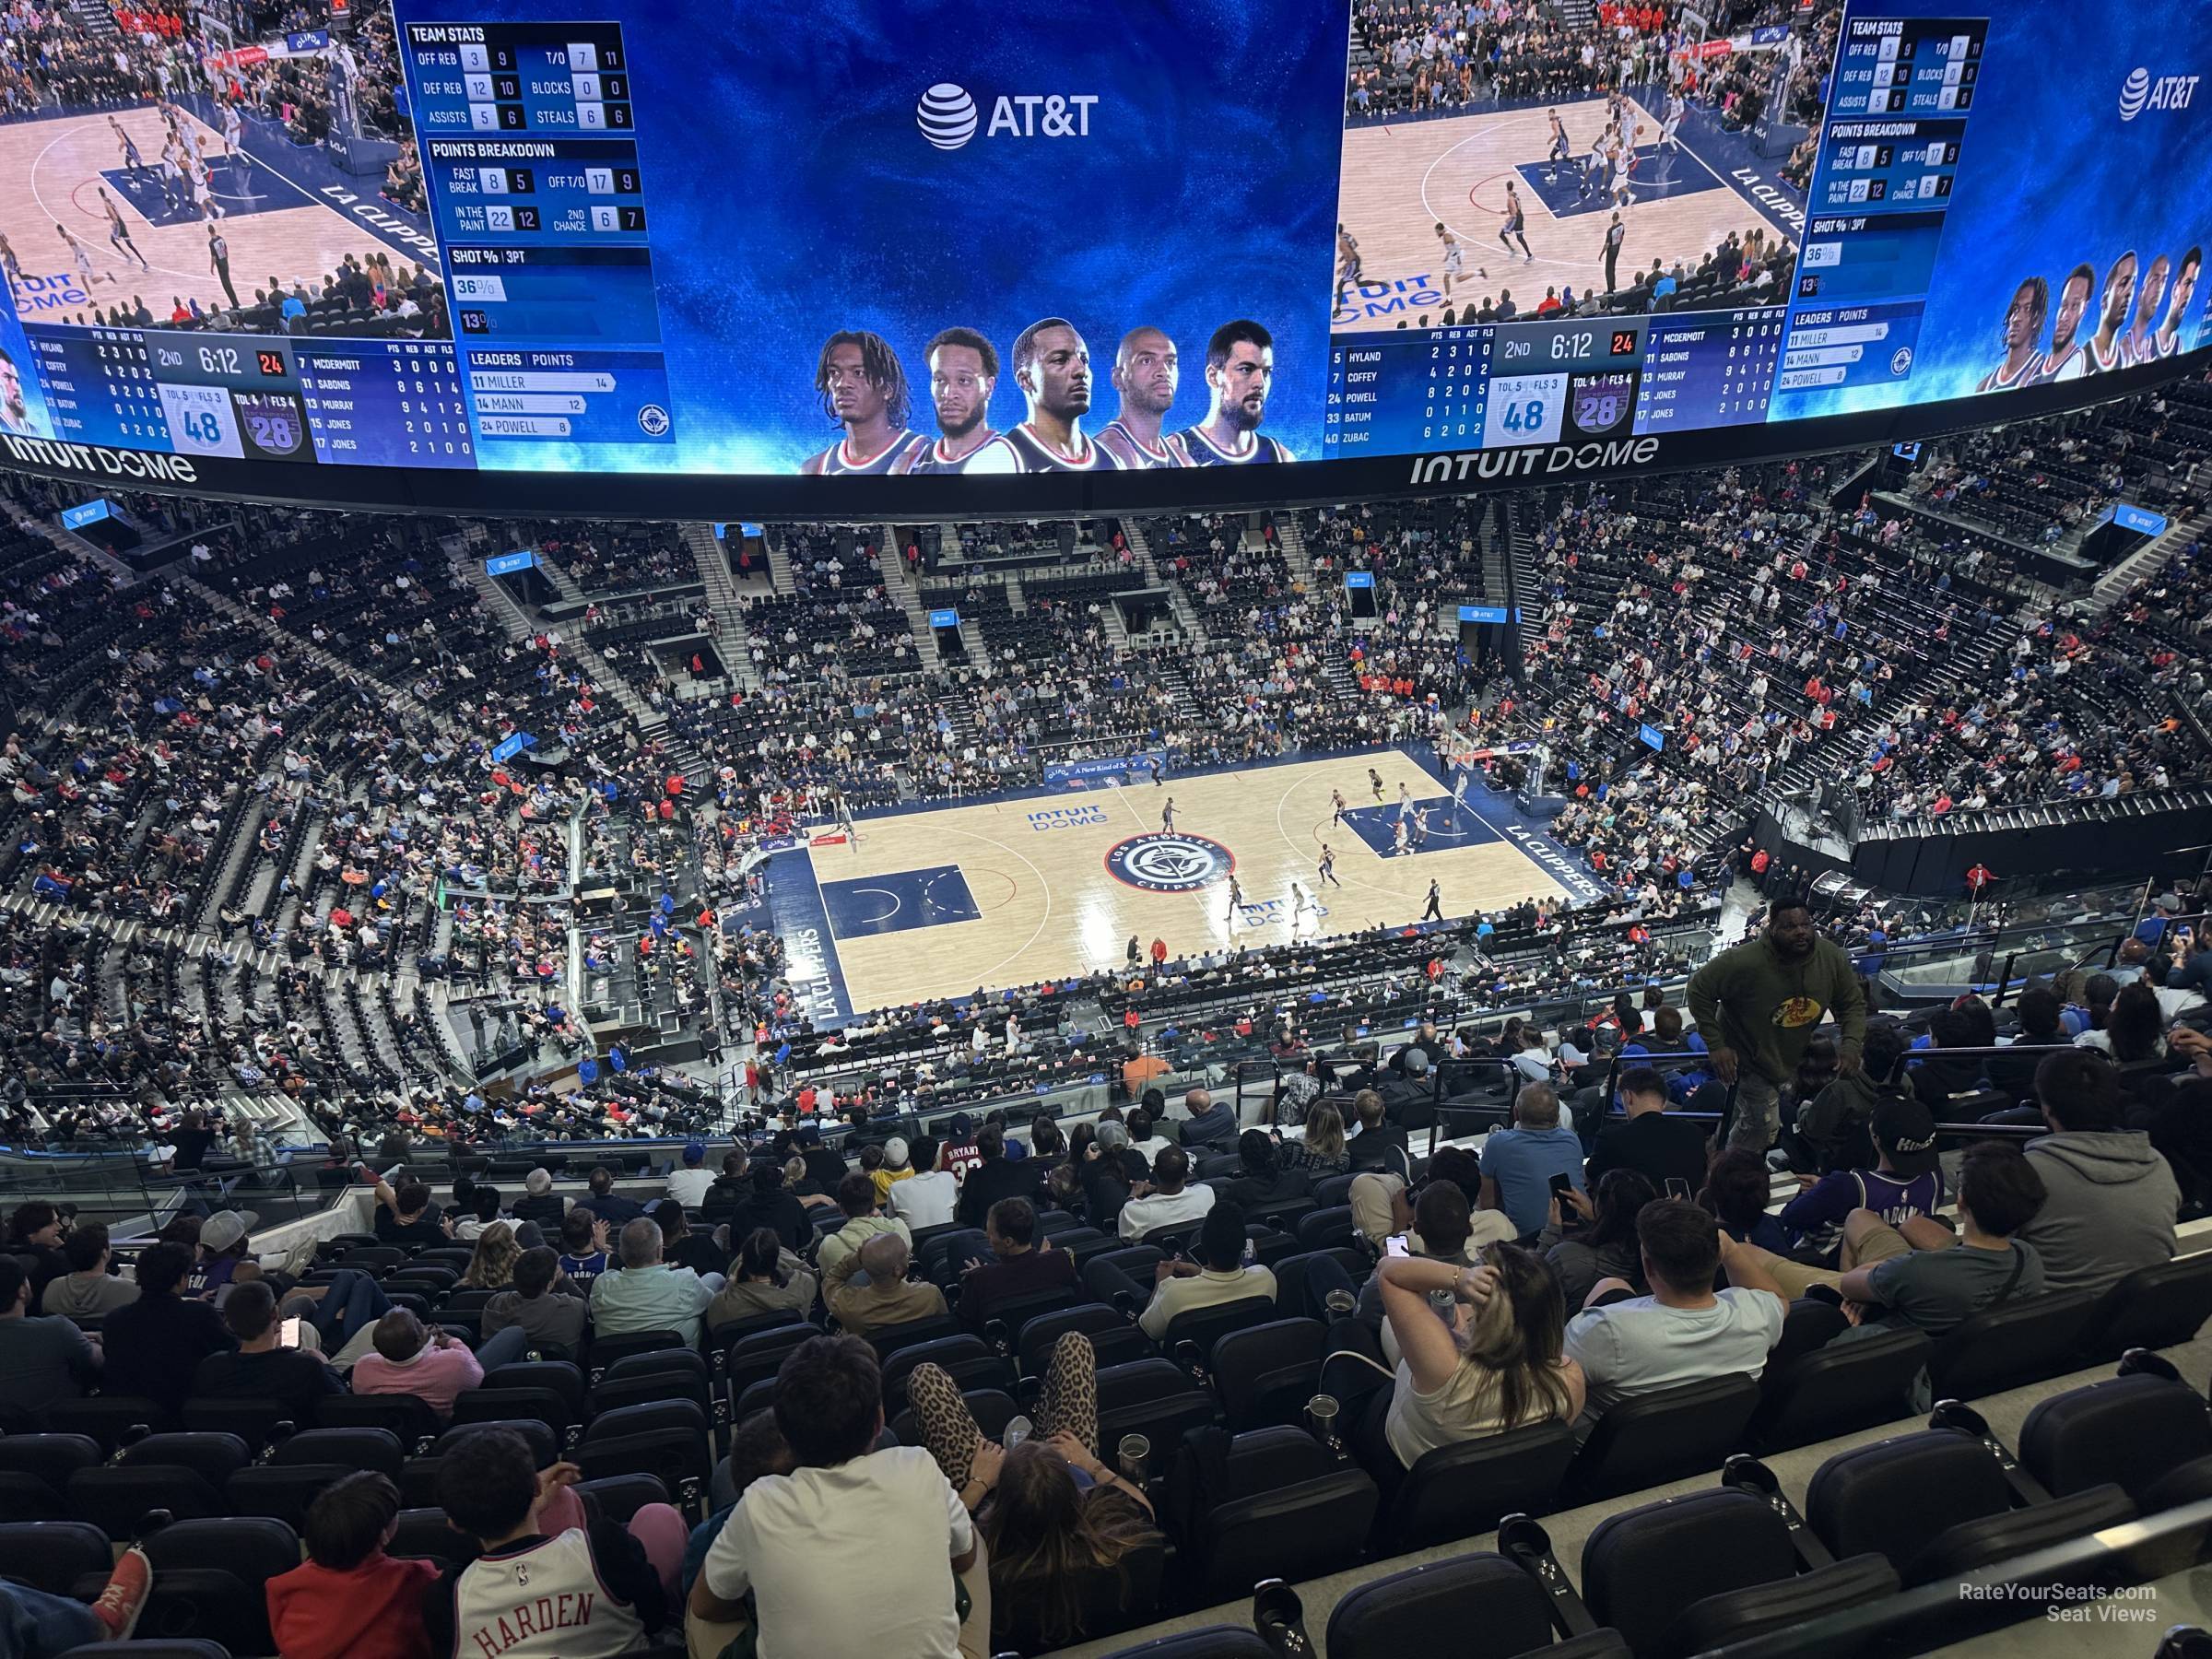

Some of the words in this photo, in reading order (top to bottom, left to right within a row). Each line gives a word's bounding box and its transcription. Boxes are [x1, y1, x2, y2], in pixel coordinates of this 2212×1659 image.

[412, 27, 446, 42] TEAM
[449, 27, 485, 42] STATS
[1853, 22, 1877, 35] TEAM
[1877, 22, 1903, 35] STATS
[418, 53, 436, 65] OFF
[439, 52, 457, 65] REB
[471, 53, 479, 65] 3
[498, 52, 507, 65] 9
[546, 52, 565, 65] T/O
[579, 52, 586, 65] 7
[606, 52, 617, 65] 11
[423, 83, 441, 95] DEF
[443, 82, 462, 94] REB
[473, 81, 487, 95] 12
[500, 81, 514, 95] 10
[532, 82, 571, 94] BLOCKS
[582, 81, 591, 95] 0
[611, 81, 619, 95] 0
[2146, 76, 2199, 110] AT&T
[429, 112, 466, 124] ASSISTS
[481, 112, 488, 124] 5
[508, 111, 516, 124] 6
[536, 111, 575, 124] STEALS
[586, 111, 595, 124] 6
[615, 111, 623, 124] 6
[987, 95, 1099, 137] AT&T
[1831, 124, 1863, 137] POINTS
[1864, 123, 1916, 137] BREAKDOWN
[432, 144, 477, 158] POINTS
[478, 144, 555, 158] BREAKDOWN
[453, 168, 476, 181] FAST
[1731, 168, 1760, 186] LA
[449, 182, 478, 194] BREAK
[489, 174, 499, 190] 8
[516, 174, 525, 190] 5
[548, 176, 568, 188] OFF
[568, 176, 585, 188] T/O
[593, 175, 606, 190] 17
[623, 174, 632, 190] 9
[321, 185, 359, 205] LA
[455, 206, 465, 218] IN
[466, 206, 484, 218] THE
[568, 209, 584, 220] 2ND
[460, 220, 486, 231] PAINT
[491, 212, 510, 227] 22
[519, 212, 535, 227] 12
[553, 221, 586, 231] CHANCE
[601, 213, 610, 227] 6
[628, 212, 636, 227] 7
[1813, 219, 1835, 233] SHOT
[1851, 218, 1866, 231] 3PT
[453, 251, 481, 264] SHOT
[484, 251, 498, 264] %
[506, 251, 524, 264] 3PT
[1794, 312, 1831, 325] LEADERS
[1839, 309, 1867, 323] POINTS
[1505, 341, 1531, 359] 2ND
[1551, 332, 1593, 359] 6:12
[1613, 335, 1632, 353] 24
[1800, 332, 1828, 345] MILLER
[158, 348, 182, 367] 2ND
[199, 347, 241, 374] 6:12
[260, 355, 283, 374] 24
[471, 353, 522, 366] LEADERS
[533, 354, 573, 367] POINTS
[1349, 351, 1382, 363] HYLAND
[1796, 353, 1819, 364] MANN
[312, 359, 360, 371] MCDERMOTT
[474, 375, 485, 388] 11
[487, 376, 525, 389] MILLER
[595, 378, 607, 388] 14
[1347, 371, 1377, 382] COFFEY
[1573, 377, 1587, 388] TOL
[1590, 376, 1596, 386] 4
[1609, 375, 1623, 385] FLS
[1625, 373, 1632, 384] 4
[1793, 372, 1822, 385] POWELL
[317, 380, 351, 390] SABONIS
[1498, 382, 1513, 392] TOL
[1515, 382, 1522, 392] 5
[1534, 380, 1548, 390] FLS
[1551, 379, 1558, 389] 3
[167, 390, 182, 399] TOL
[182, 392, 188, 401] 5
[199, 393, 213, 402] FLS
[216, 393, 221, 403] 3
[235, 394, 250, 405] TOL
[252, 394, 259, 406] 4
[271, 396, 287, 406] FLS
[288, 397, 296, 407] 4
[1346, 393, 1377, 403] POWELL
[322, 400, 353, 410] MURRAY
[477, 398, 489, 409] 14
[491, 398, 524, 410] MANN
[569, 400, 580, 410] 12
[1344, 412, 1371, 423] BATUM
[1503, 400, 1544, 431] 48
[1577, 396, 1617, 427] 28
[185, 411, 220, 443] 48
[326, 419, 351, 429] JONES
[481, 420, 492, 430] 24
[496, 420, 538, 433] POWELL
[559, 422, 567, 432] 8
[252, 417, 293, 448] 28
[1343, 432, 1369, 443] ZUBAC
[332, 440, 357, 450] JONES
[1410, 449, 1545, 484] INTUIT
[1112, 845, 1129, 862] LOS
[1505, 825, 1532, 841] LA
[1525, 841, 1603, 897] CLIPPERS
[816, 997, 839, 1020] LA
[188, 1275, 208, 1289] FOX
[473, 1593, 594, 1659] HARDEN
